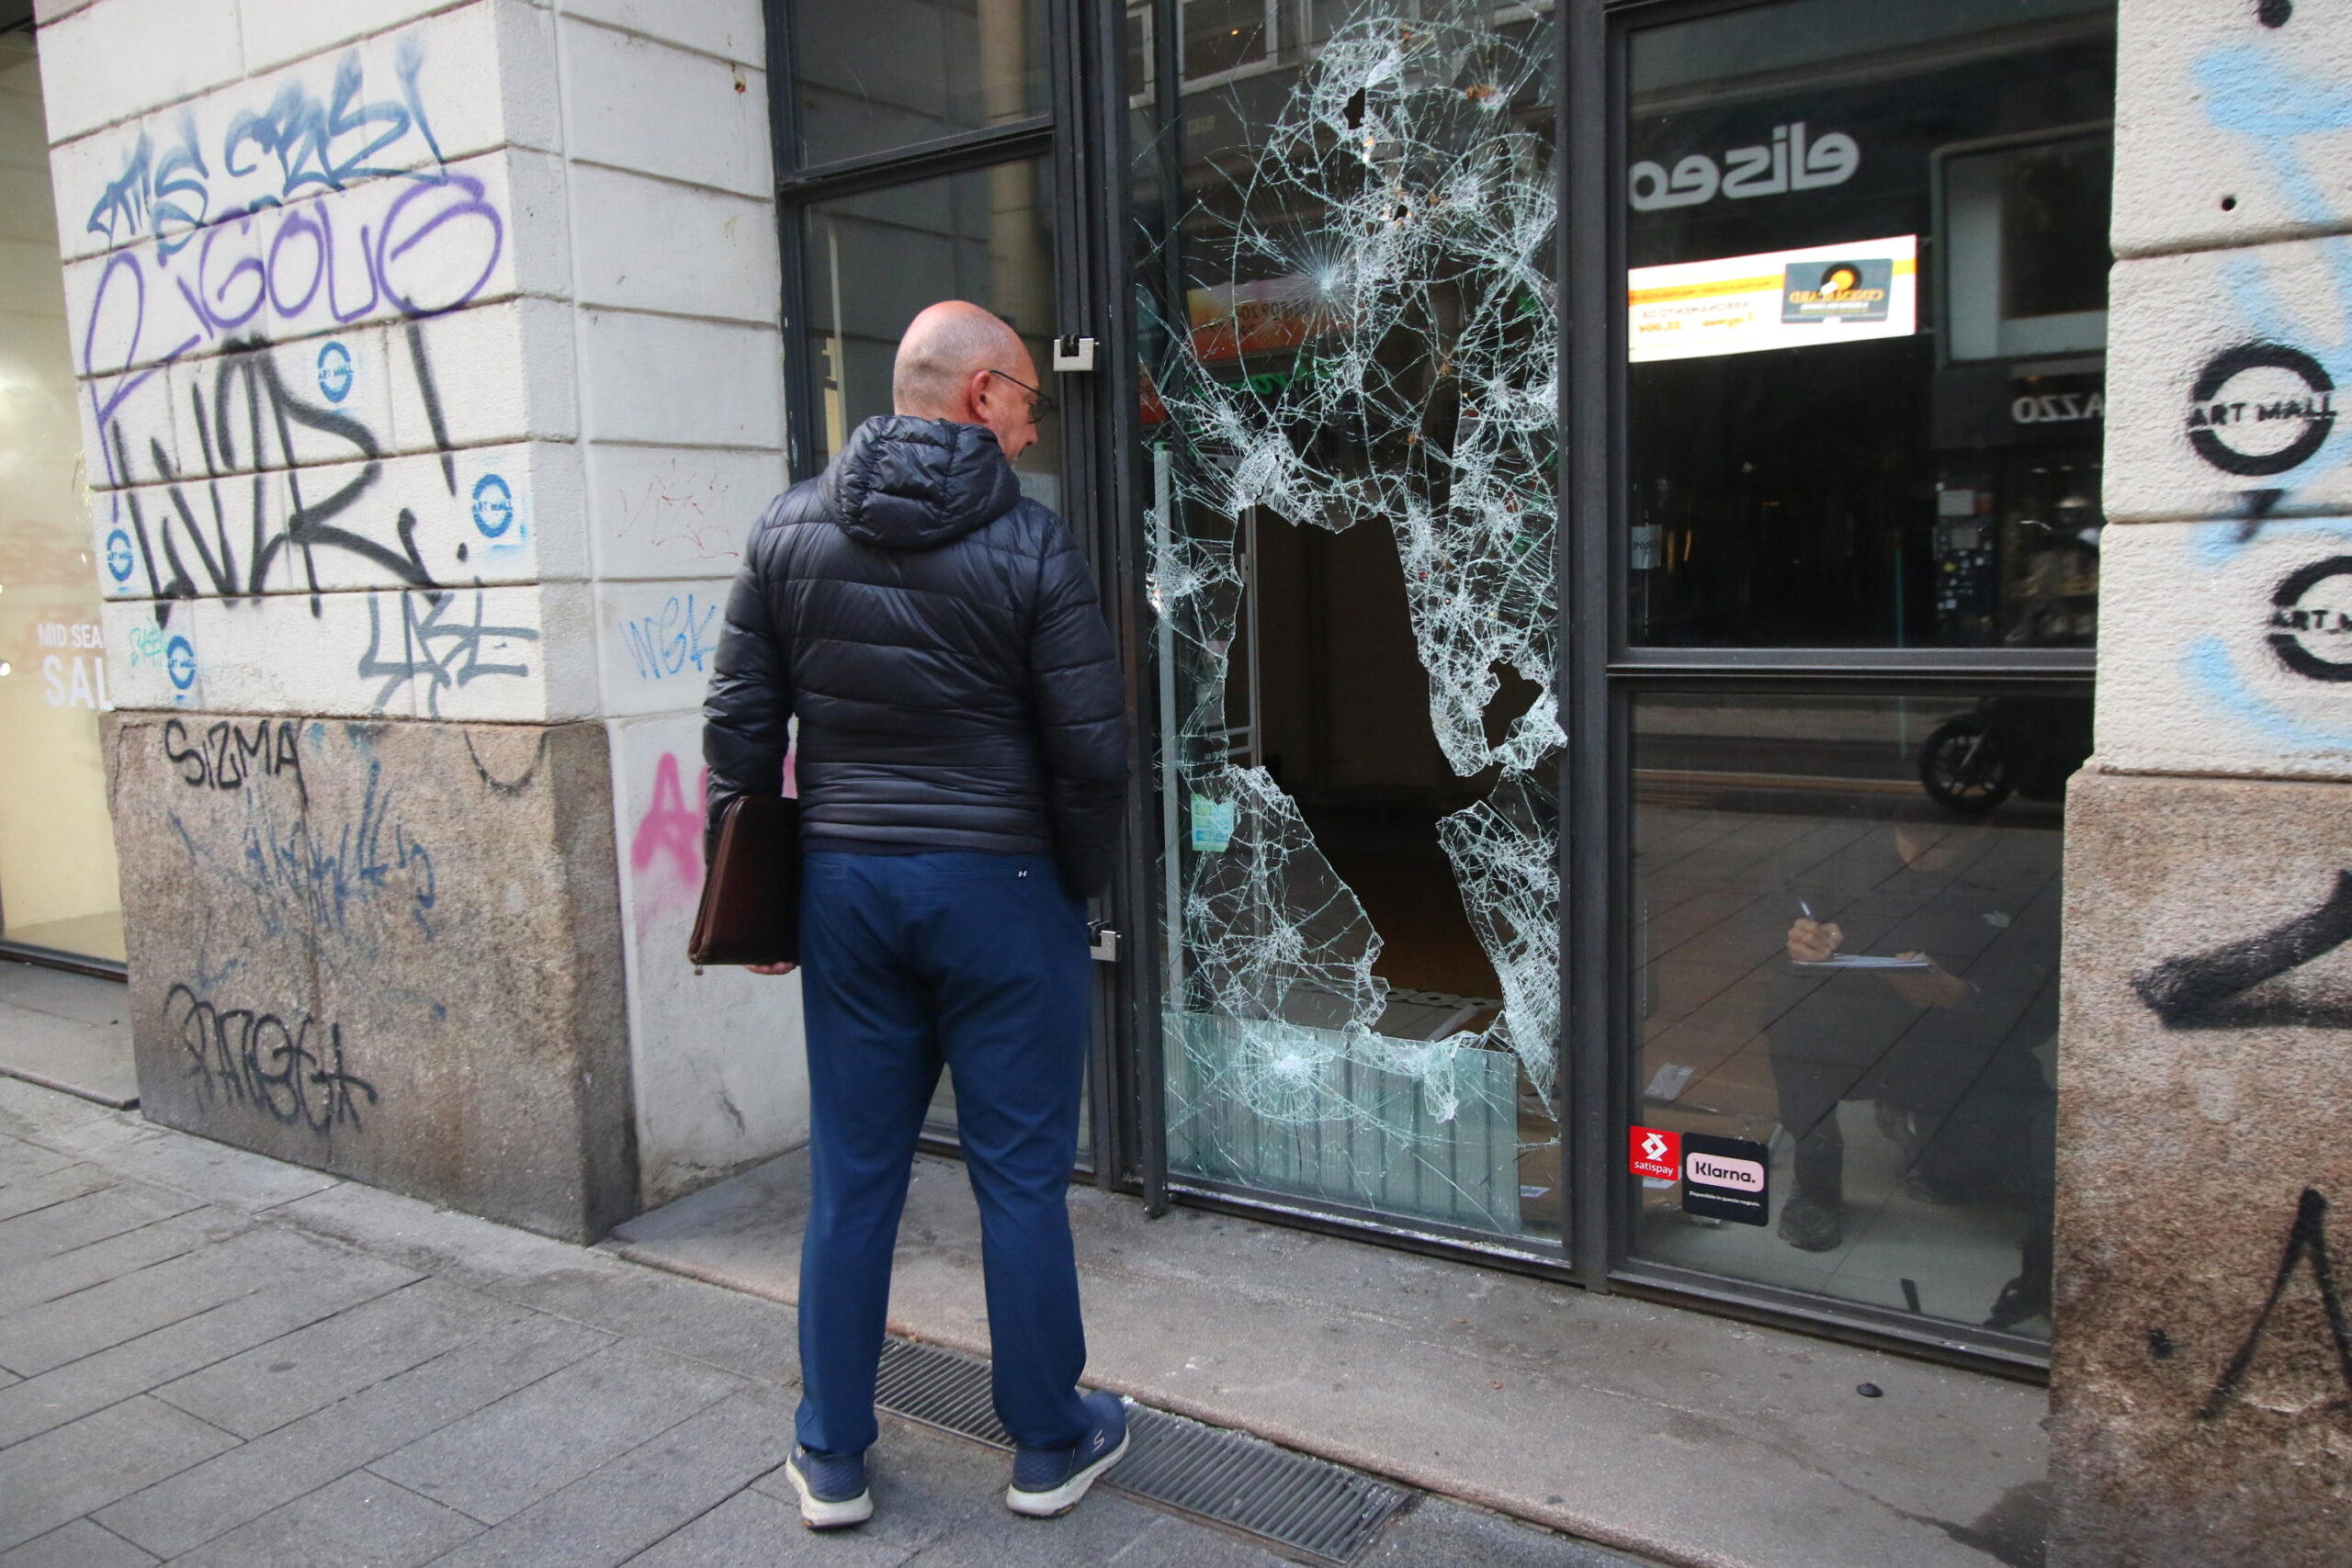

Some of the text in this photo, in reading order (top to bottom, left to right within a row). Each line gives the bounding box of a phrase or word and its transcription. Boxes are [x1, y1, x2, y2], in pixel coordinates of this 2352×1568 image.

[2188, 402, 2247, 427] ART
[38, 623, 67, 647] MID
[1634, 1161, 1674, 1177] satispay
